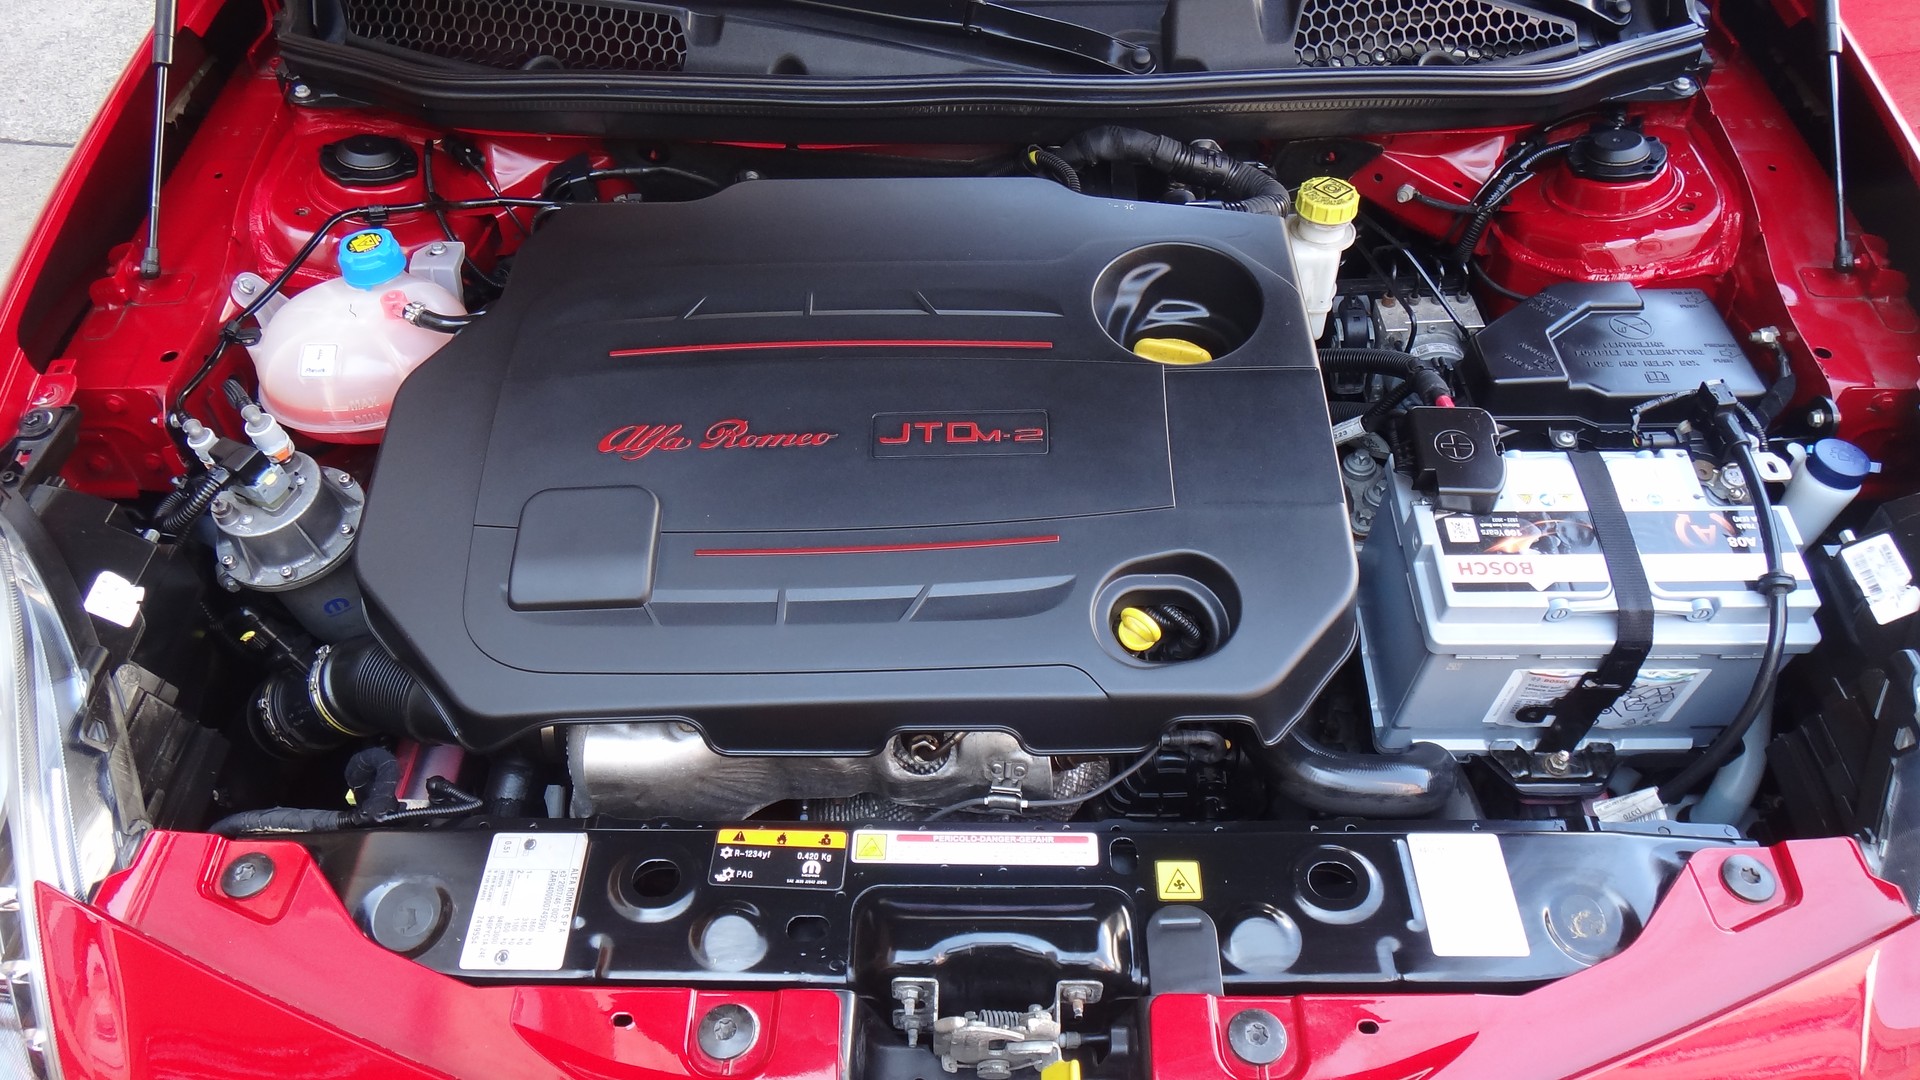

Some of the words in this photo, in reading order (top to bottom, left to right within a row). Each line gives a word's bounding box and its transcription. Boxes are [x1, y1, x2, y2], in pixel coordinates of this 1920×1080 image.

[347, 396, 380, 411] MAX
[598, 423, 692, 461] Alfa
[698, 418, 840, 451] Romeo
[1726, 536, 1757, 548] A08
[1457, 561, 1534, 576] BOSCH
[932, 834, 1055, 844] PERICOLO-DANGER-GEFAHR
[733, 849, 772, 860] R-1234yf
[797, 852, 819, 860] 0.420
[821, 853, 832, 862] Kg
[569, 867, 579, 885] ALFA
[736, 870, 754, 879] PAG
[564, 887, 574, 912] ROMEO
